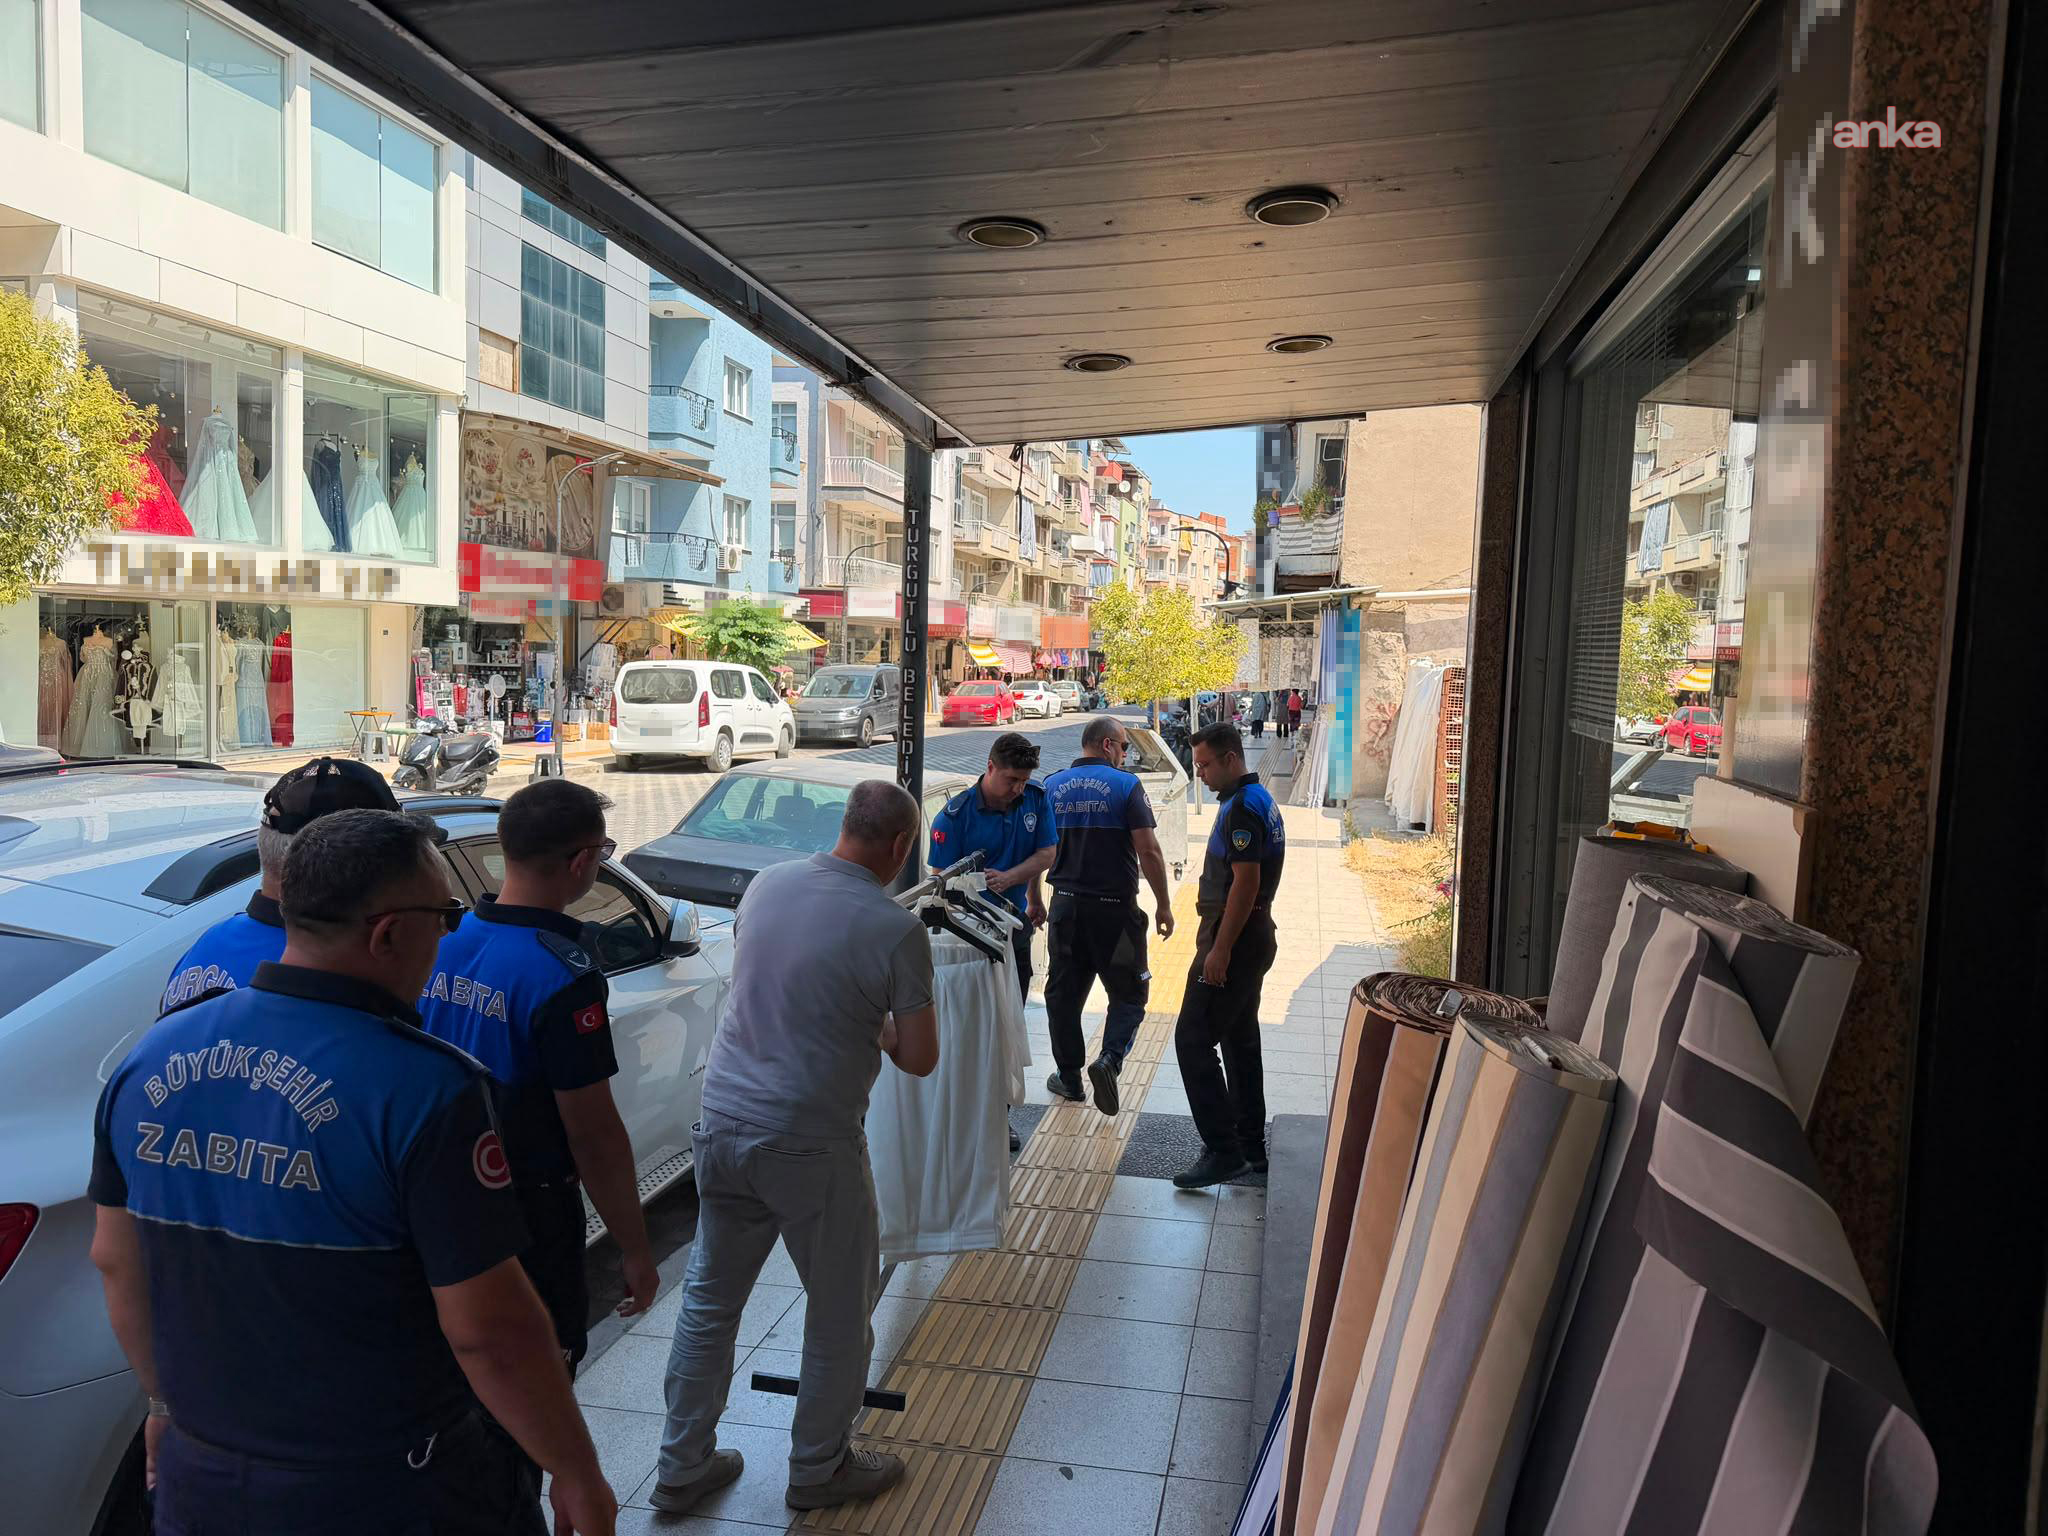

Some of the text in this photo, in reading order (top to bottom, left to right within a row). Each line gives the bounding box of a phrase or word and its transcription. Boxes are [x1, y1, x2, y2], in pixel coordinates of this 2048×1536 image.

[904, 509, 920, 652] TURGUTLU
[1055, 801, 1109, 814] ZABITA
[144, 1039, 339, 1133] BÜYÜKŞEHİR
[136, 1121, 321, 1191] ZABITA
